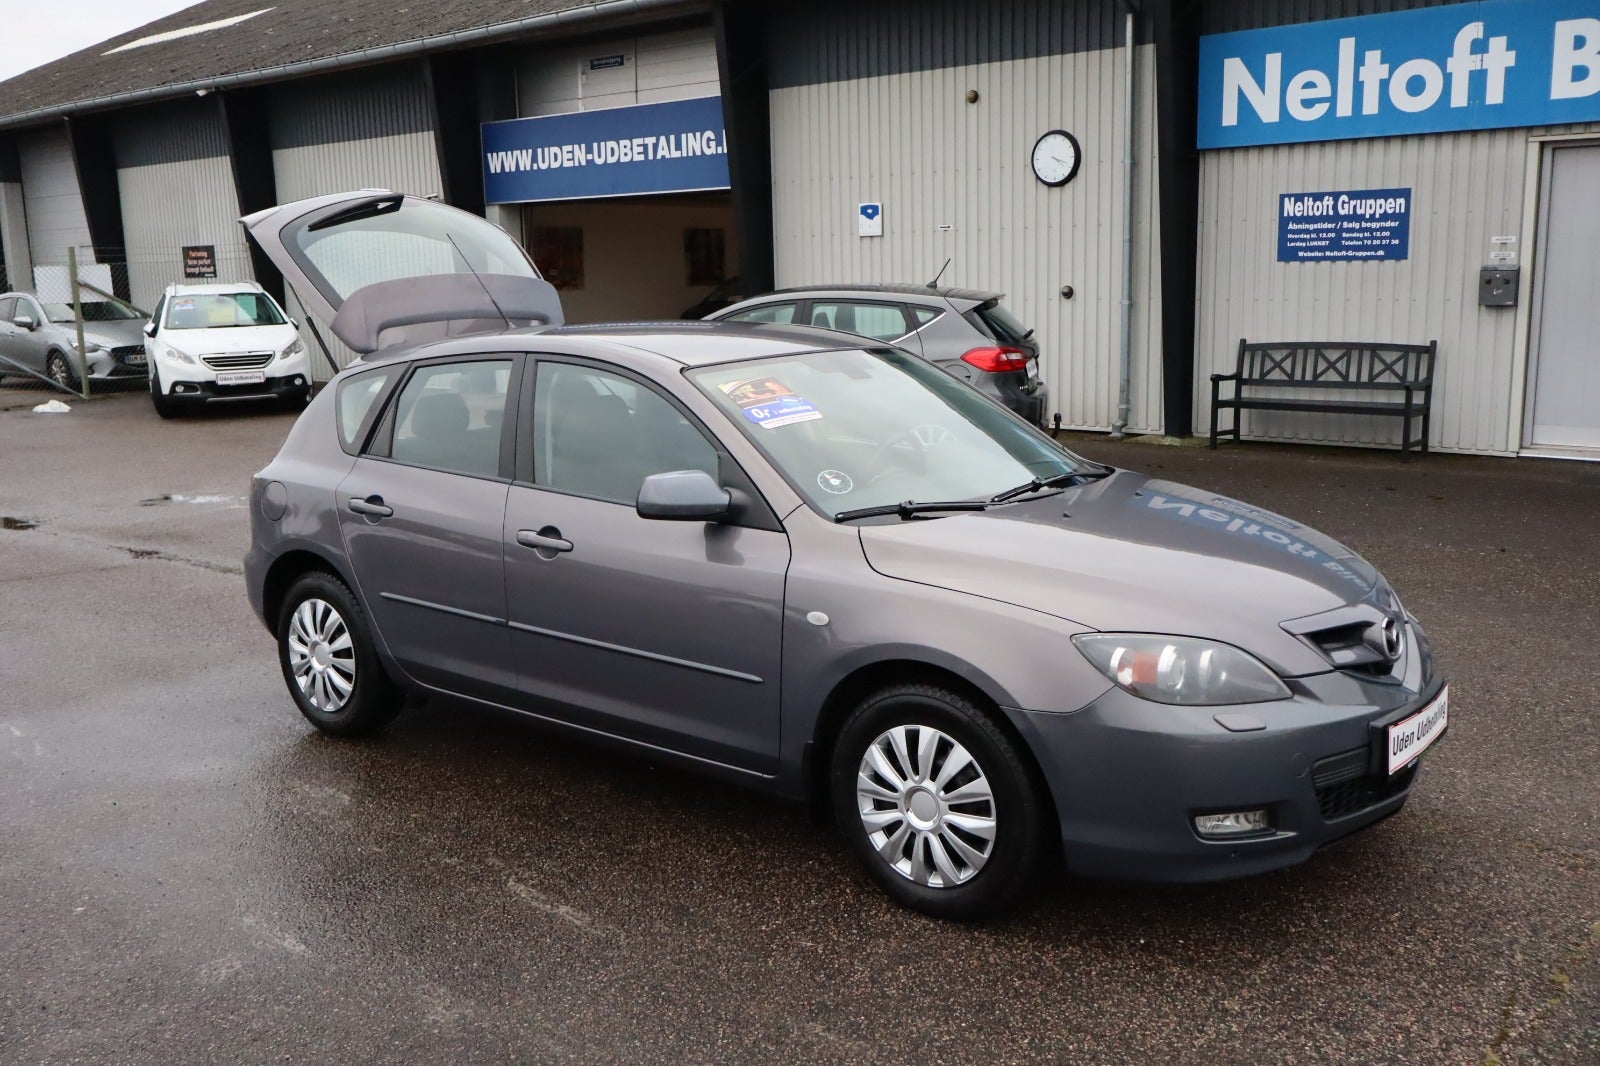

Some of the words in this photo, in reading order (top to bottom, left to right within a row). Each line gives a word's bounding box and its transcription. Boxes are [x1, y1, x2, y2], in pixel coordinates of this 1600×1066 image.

[1221, 21, 1516, 127] Neltoft
[487, 129, 728, 174] WWW.UDEN-UDBETALING.
[1283, 195, 1334, 217] Neltoft
[1337, 194, 1405, 218] Gruppen
[1287, 221, 1336, 230] Åbningstider
[1361, 220, 1400, 228] begynder
[1392, 730, 1415, 756] Uden
[1416, 700, 1446, 742] Udbetaling
